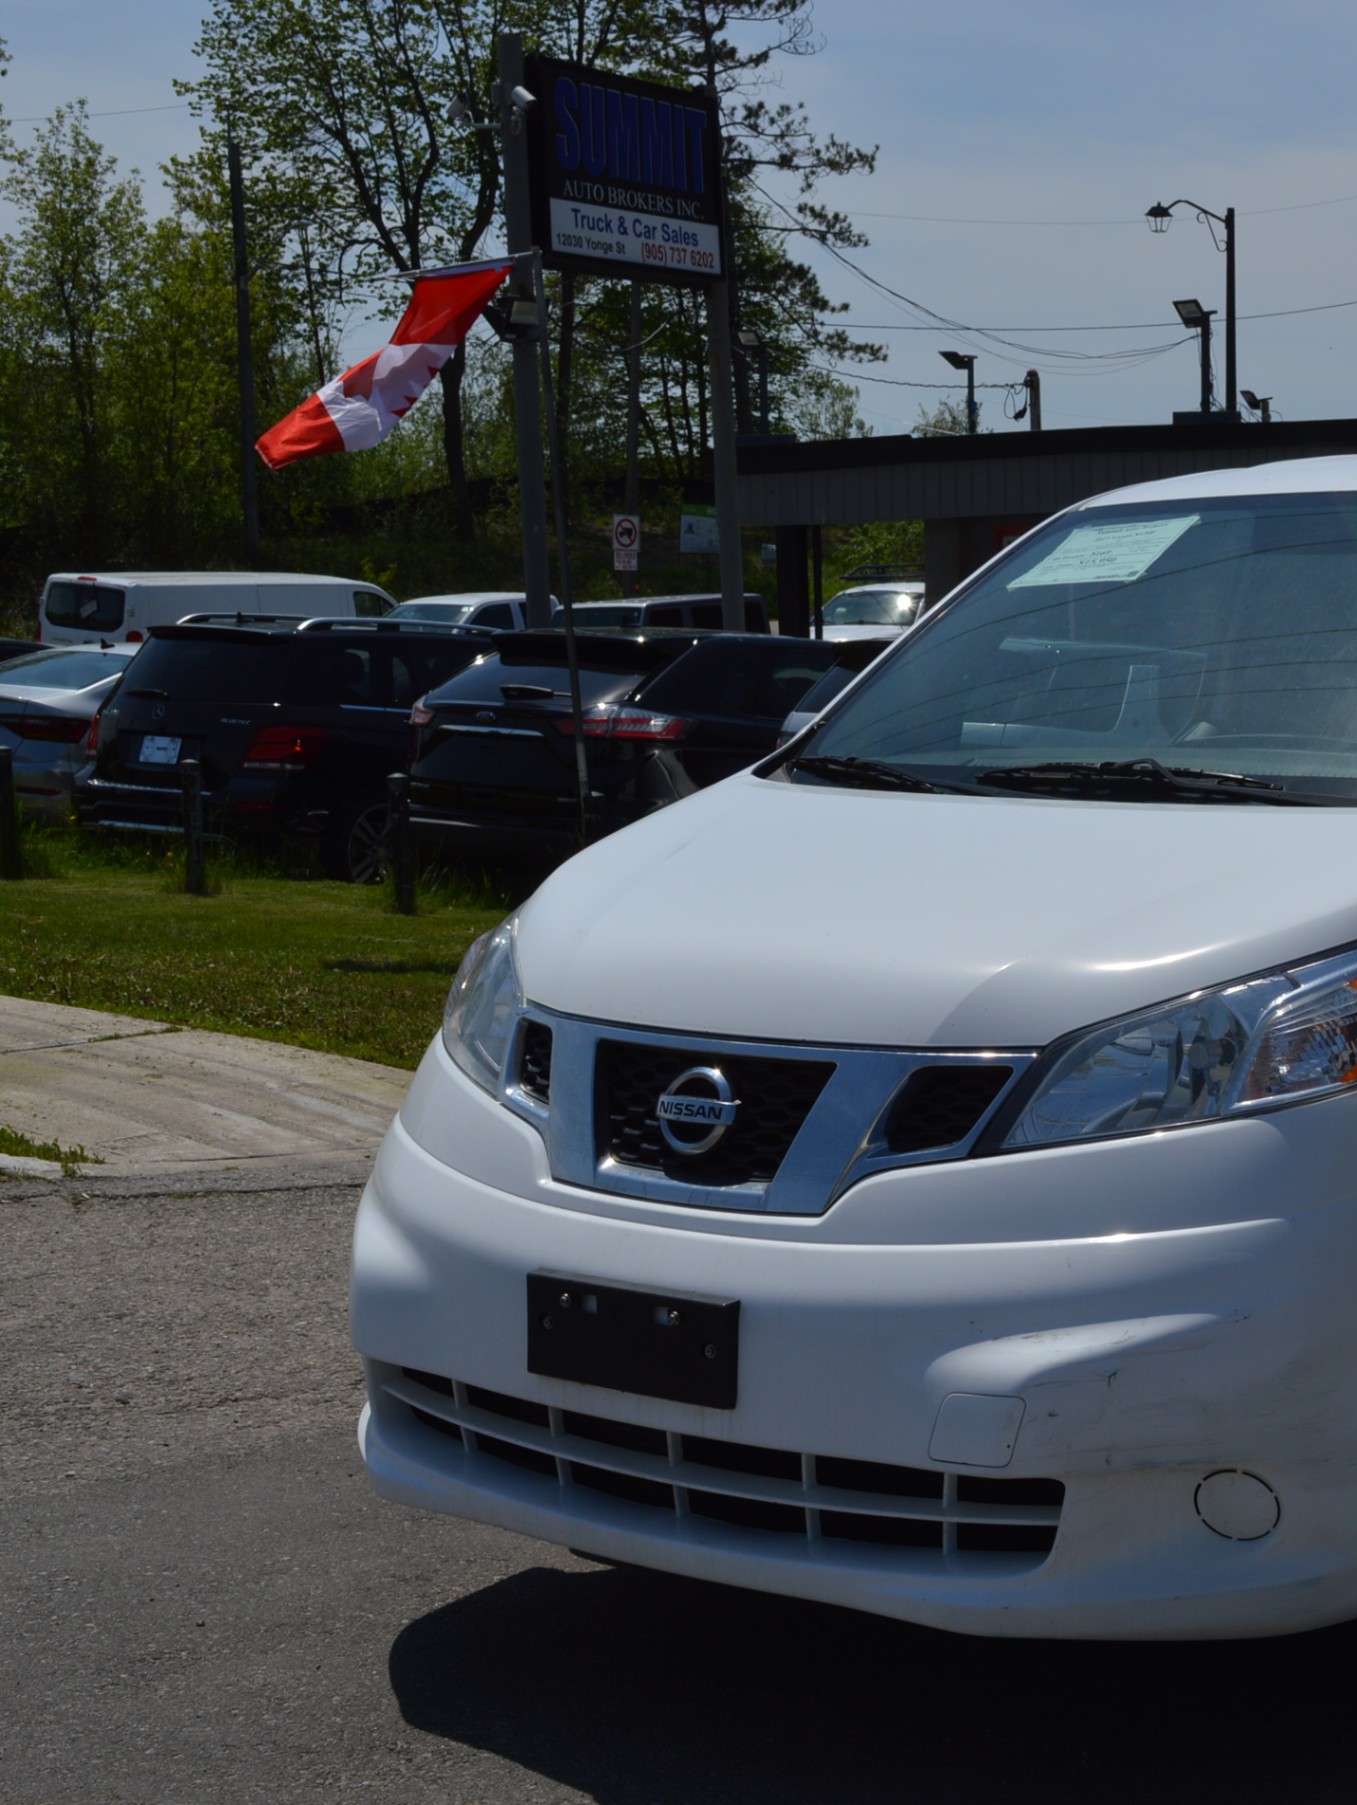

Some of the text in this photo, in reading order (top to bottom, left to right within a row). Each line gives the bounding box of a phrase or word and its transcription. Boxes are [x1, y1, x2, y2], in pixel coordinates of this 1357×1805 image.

[555, 76, 707, 194] SUMMIT
[563, 179, 705, 220] AUTO BROKERS INC.
[556, 233, 626, 255] 12030 Yonge St
[571, 208, 699, 247] Truck & Car Sales
[641, 241, 714, 269] (905) 737 6202
[659, 1100, 722, 1120] NISSAN
